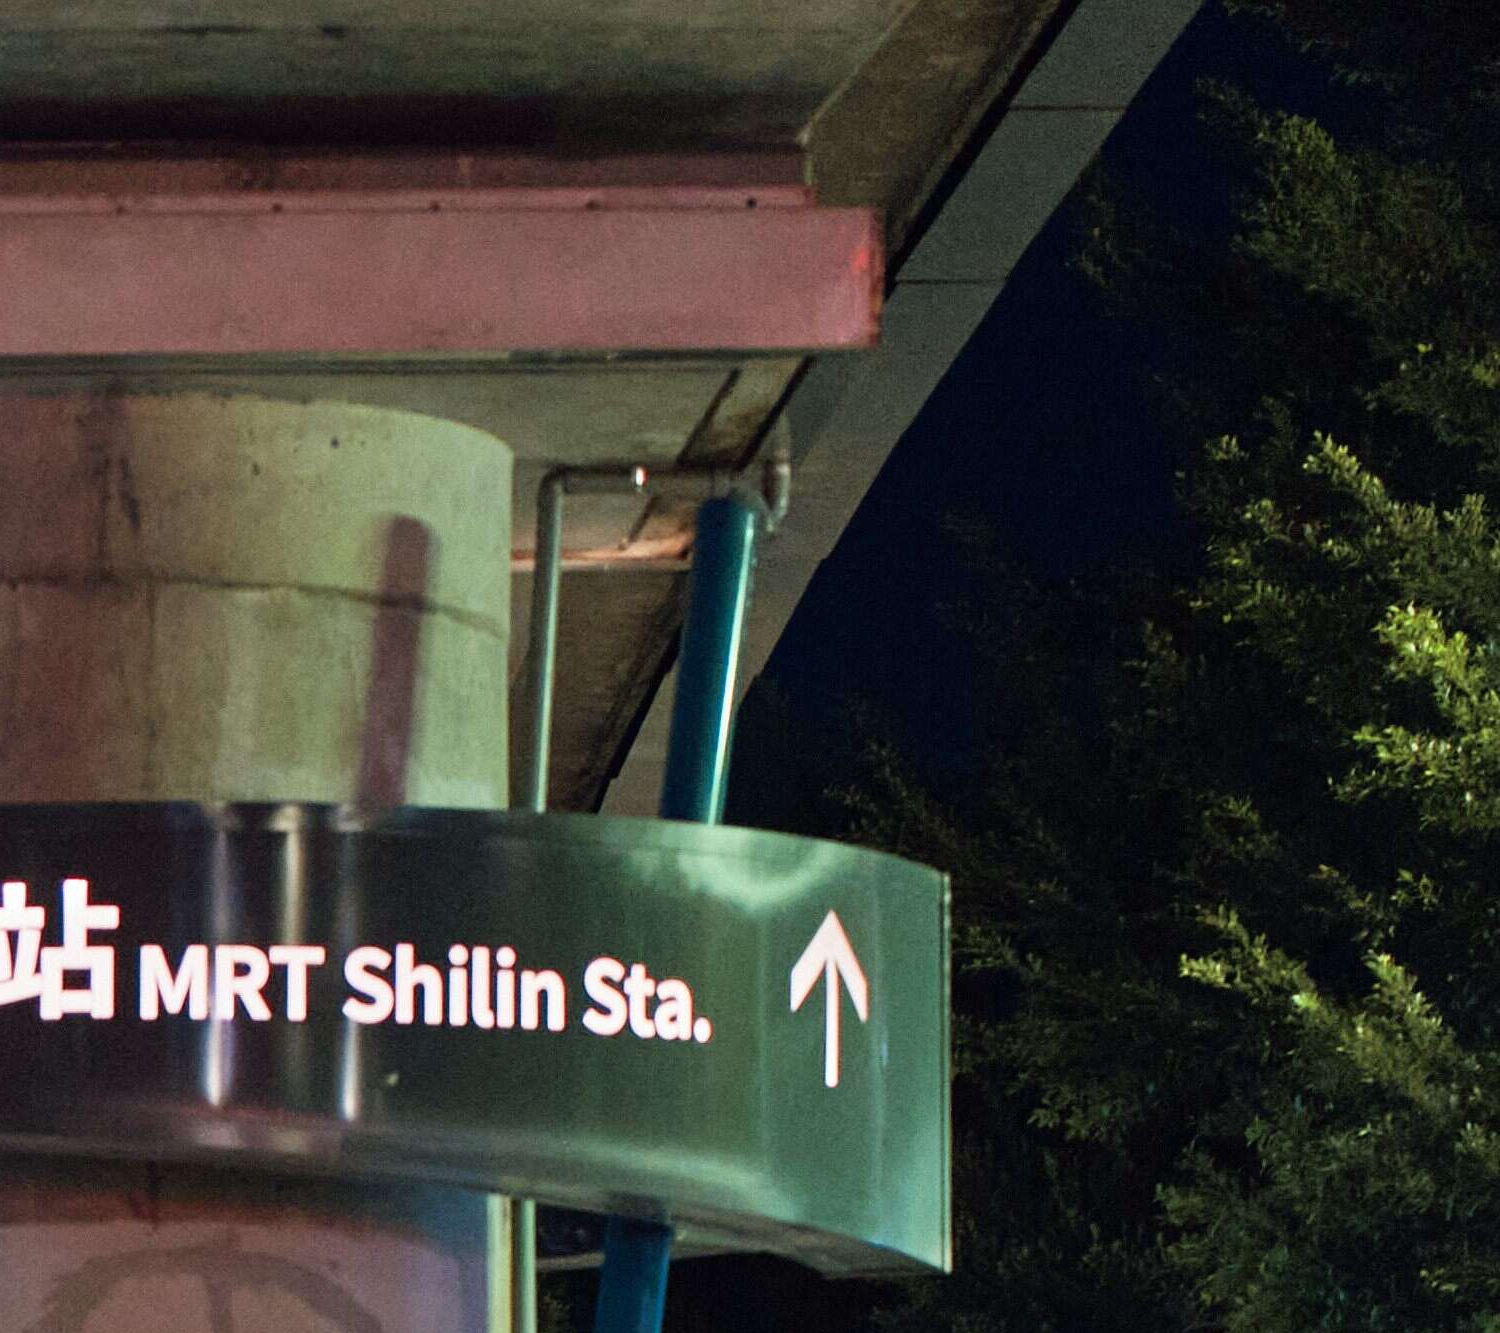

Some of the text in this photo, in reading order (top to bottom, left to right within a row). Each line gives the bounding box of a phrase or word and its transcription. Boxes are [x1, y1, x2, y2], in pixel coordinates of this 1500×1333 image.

[138, 944, 325, 1022] MRT
[341, 943, 565, 1032] Shilin
[580, 957, 712, 1044] Sta.
